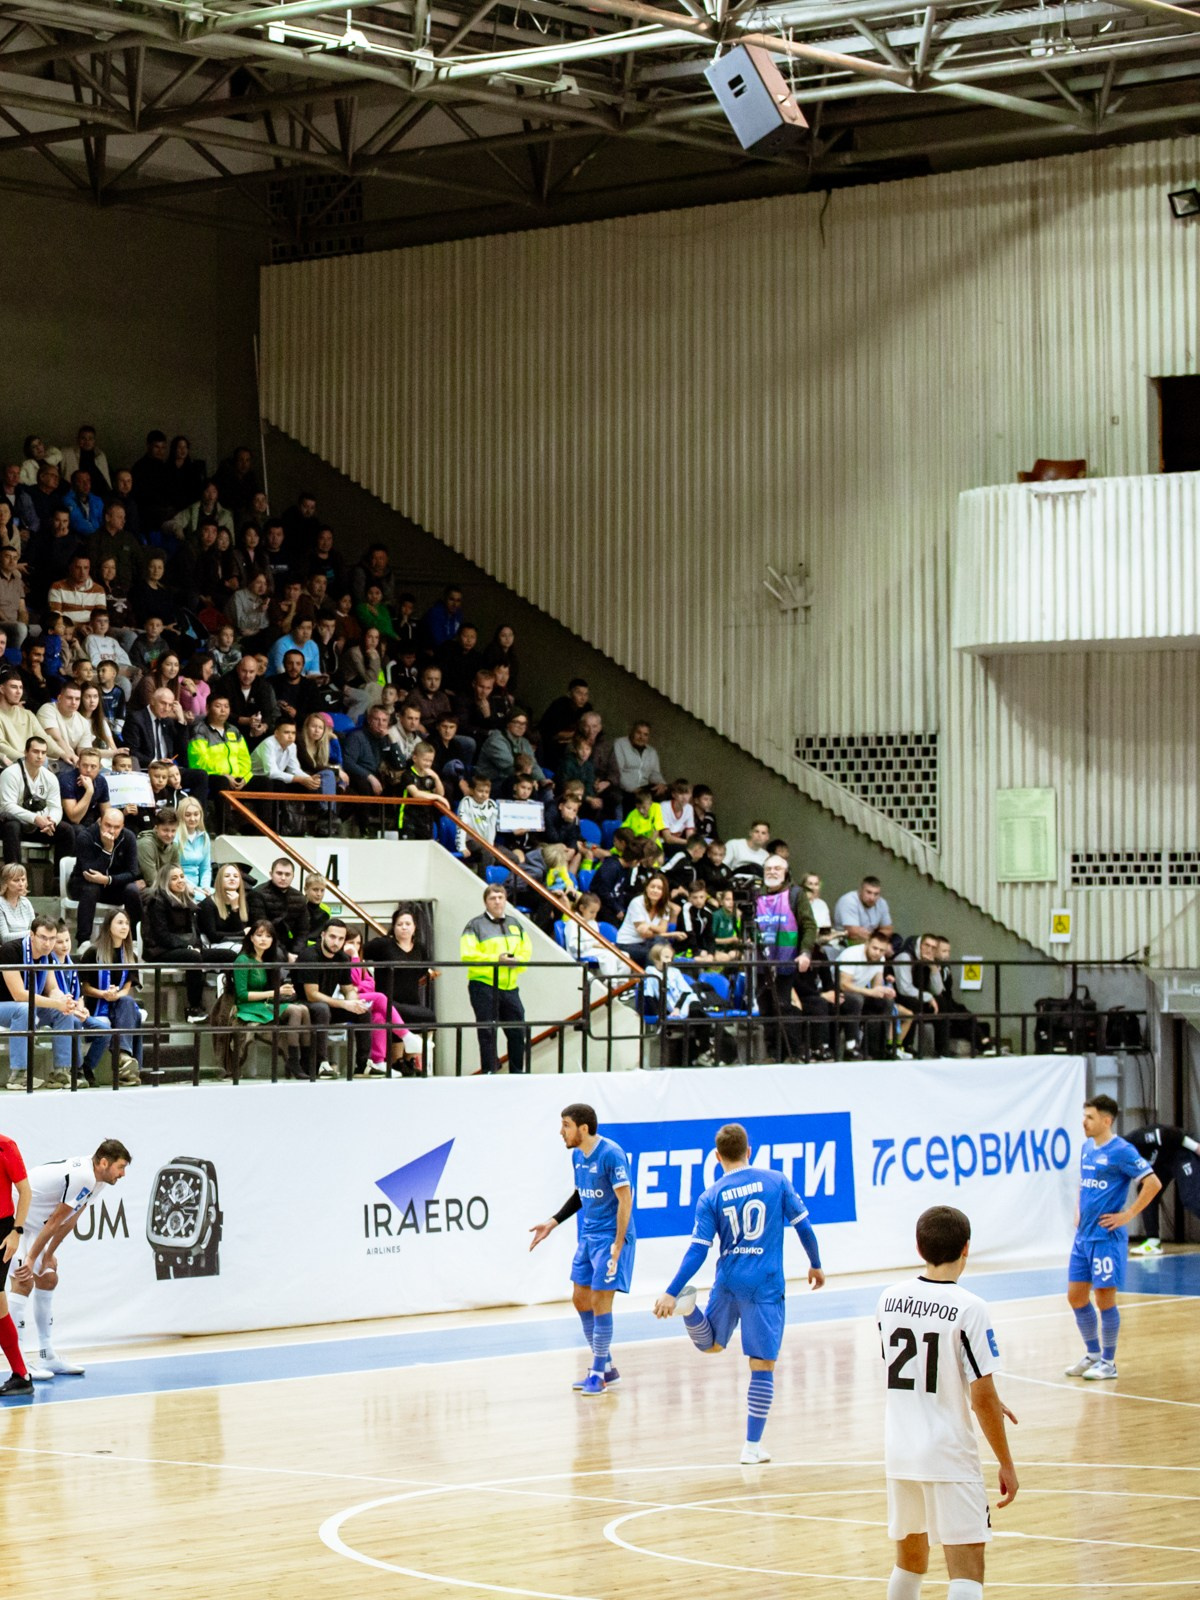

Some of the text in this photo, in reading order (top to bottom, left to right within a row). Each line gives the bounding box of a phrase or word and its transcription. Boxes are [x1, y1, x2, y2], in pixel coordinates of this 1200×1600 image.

[326, 854, 340, 886] 4
[364, 1196, 489, 1238] IRAERO
[723, 1199, 767, 1245] 10
[366, 1245, 401, 1255] AIRLINES
[1093, 1256, 1114, 1276] 30
[884, 1295, 959, 1322] ШАЙДУРОВ
[887, 1327, 940, 1394] 21
